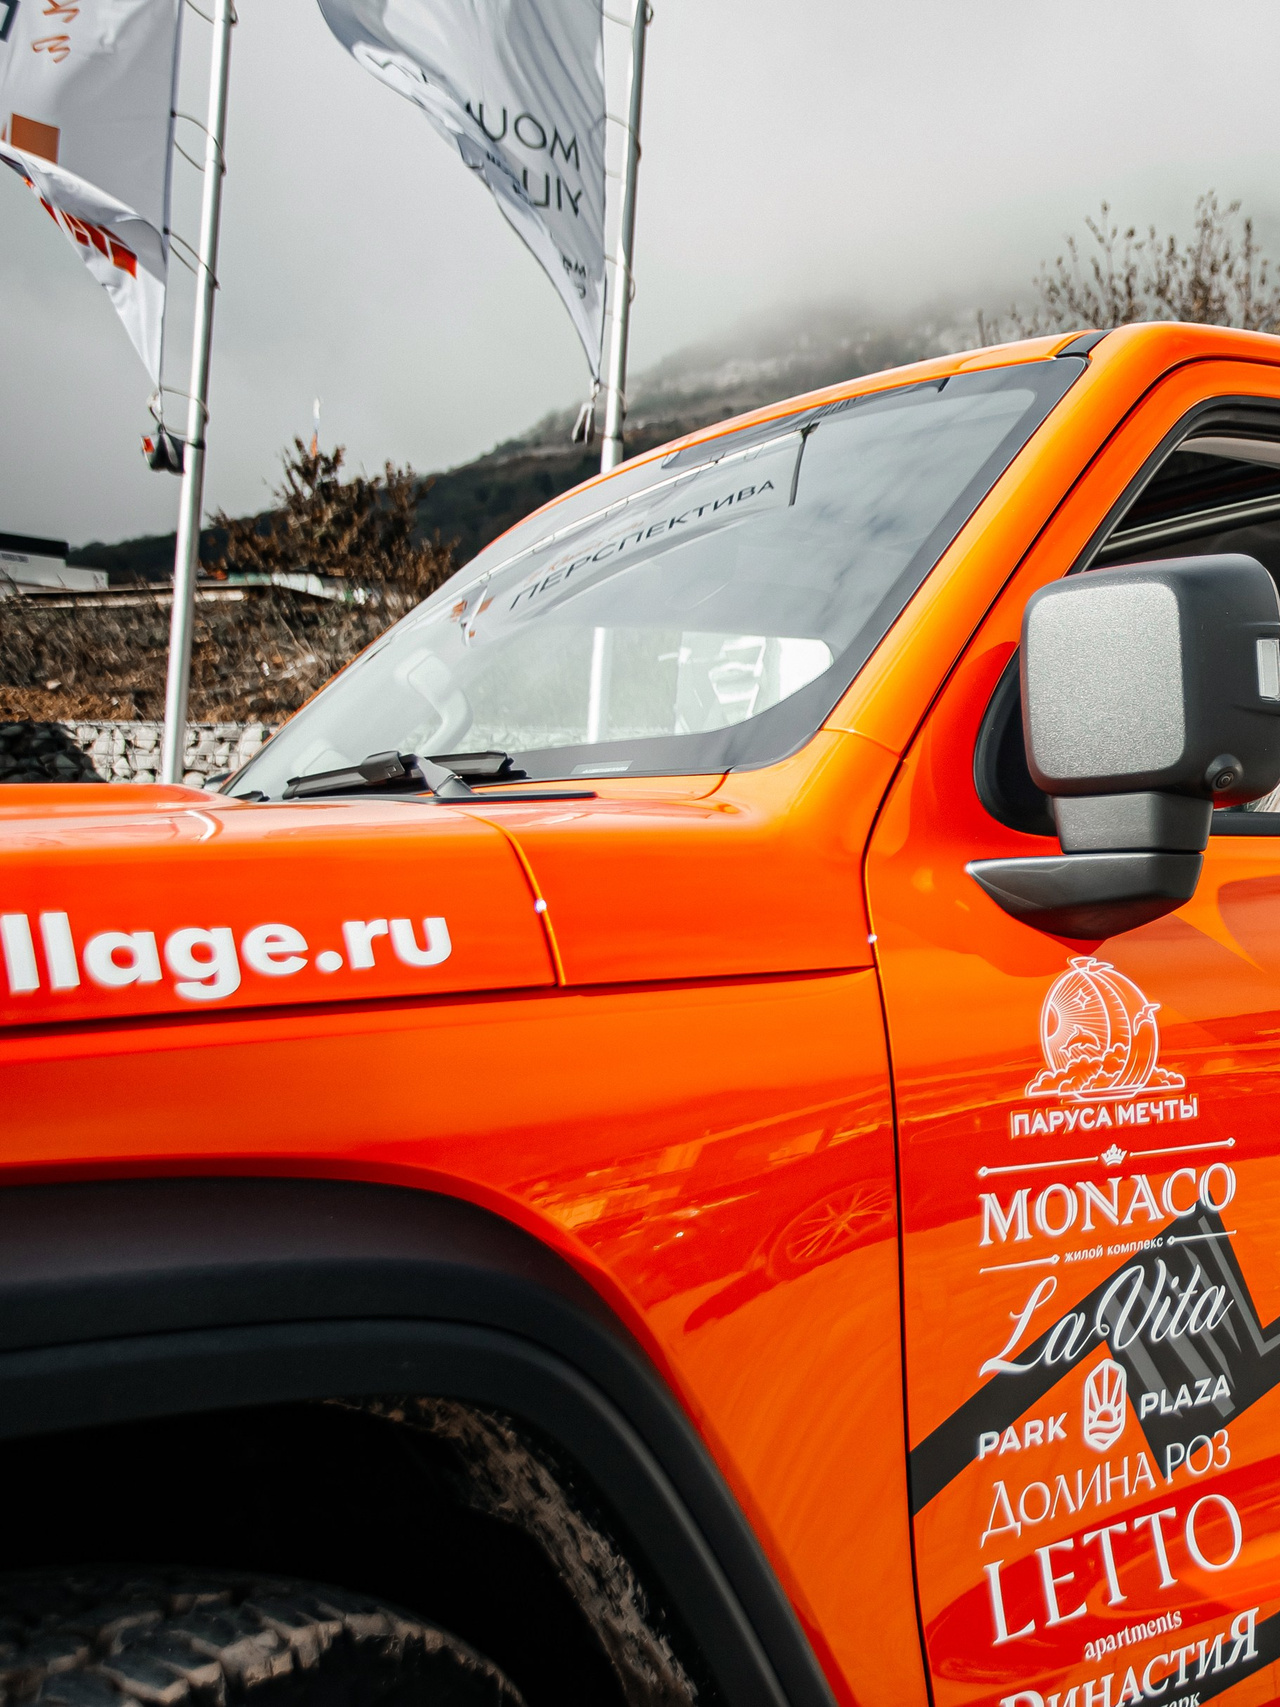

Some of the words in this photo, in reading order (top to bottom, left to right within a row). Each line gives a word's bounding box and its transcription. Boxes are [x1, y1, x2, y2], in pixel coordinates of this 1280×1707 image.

[509, 479, 775, 611] ПЕРСПЕКТИВА
[1, 911, 453, 1000] llage.ru
[1012, 1106, 1112, 1138] ПАРУСА
[1117, 1096, 1198, 1127] МЕЧТЫ
[977, 1162, 1238, 1247] MONACO
[1064, 1245, 1104, 1263] жилой
[1106, 1236, 1164, 1257] комплекс
[979, 1275, 1097, 1378] La
[1095, 1258, 1235, 1350] Vita
[978, 1411, 1069, 1461] PARK
[1139, 1373, 1232, 1421] PLAZA
[980, 1450, 1157, 1549] ДОЛИНА
[1165, 1428, 1232, 1484] РОЗ
[983, 1493, 1244, 1647] LETTO
[999, 1606, 1260, 1707] НАСТИЯ
[1083, 1609, 1183, 1663] apartments
